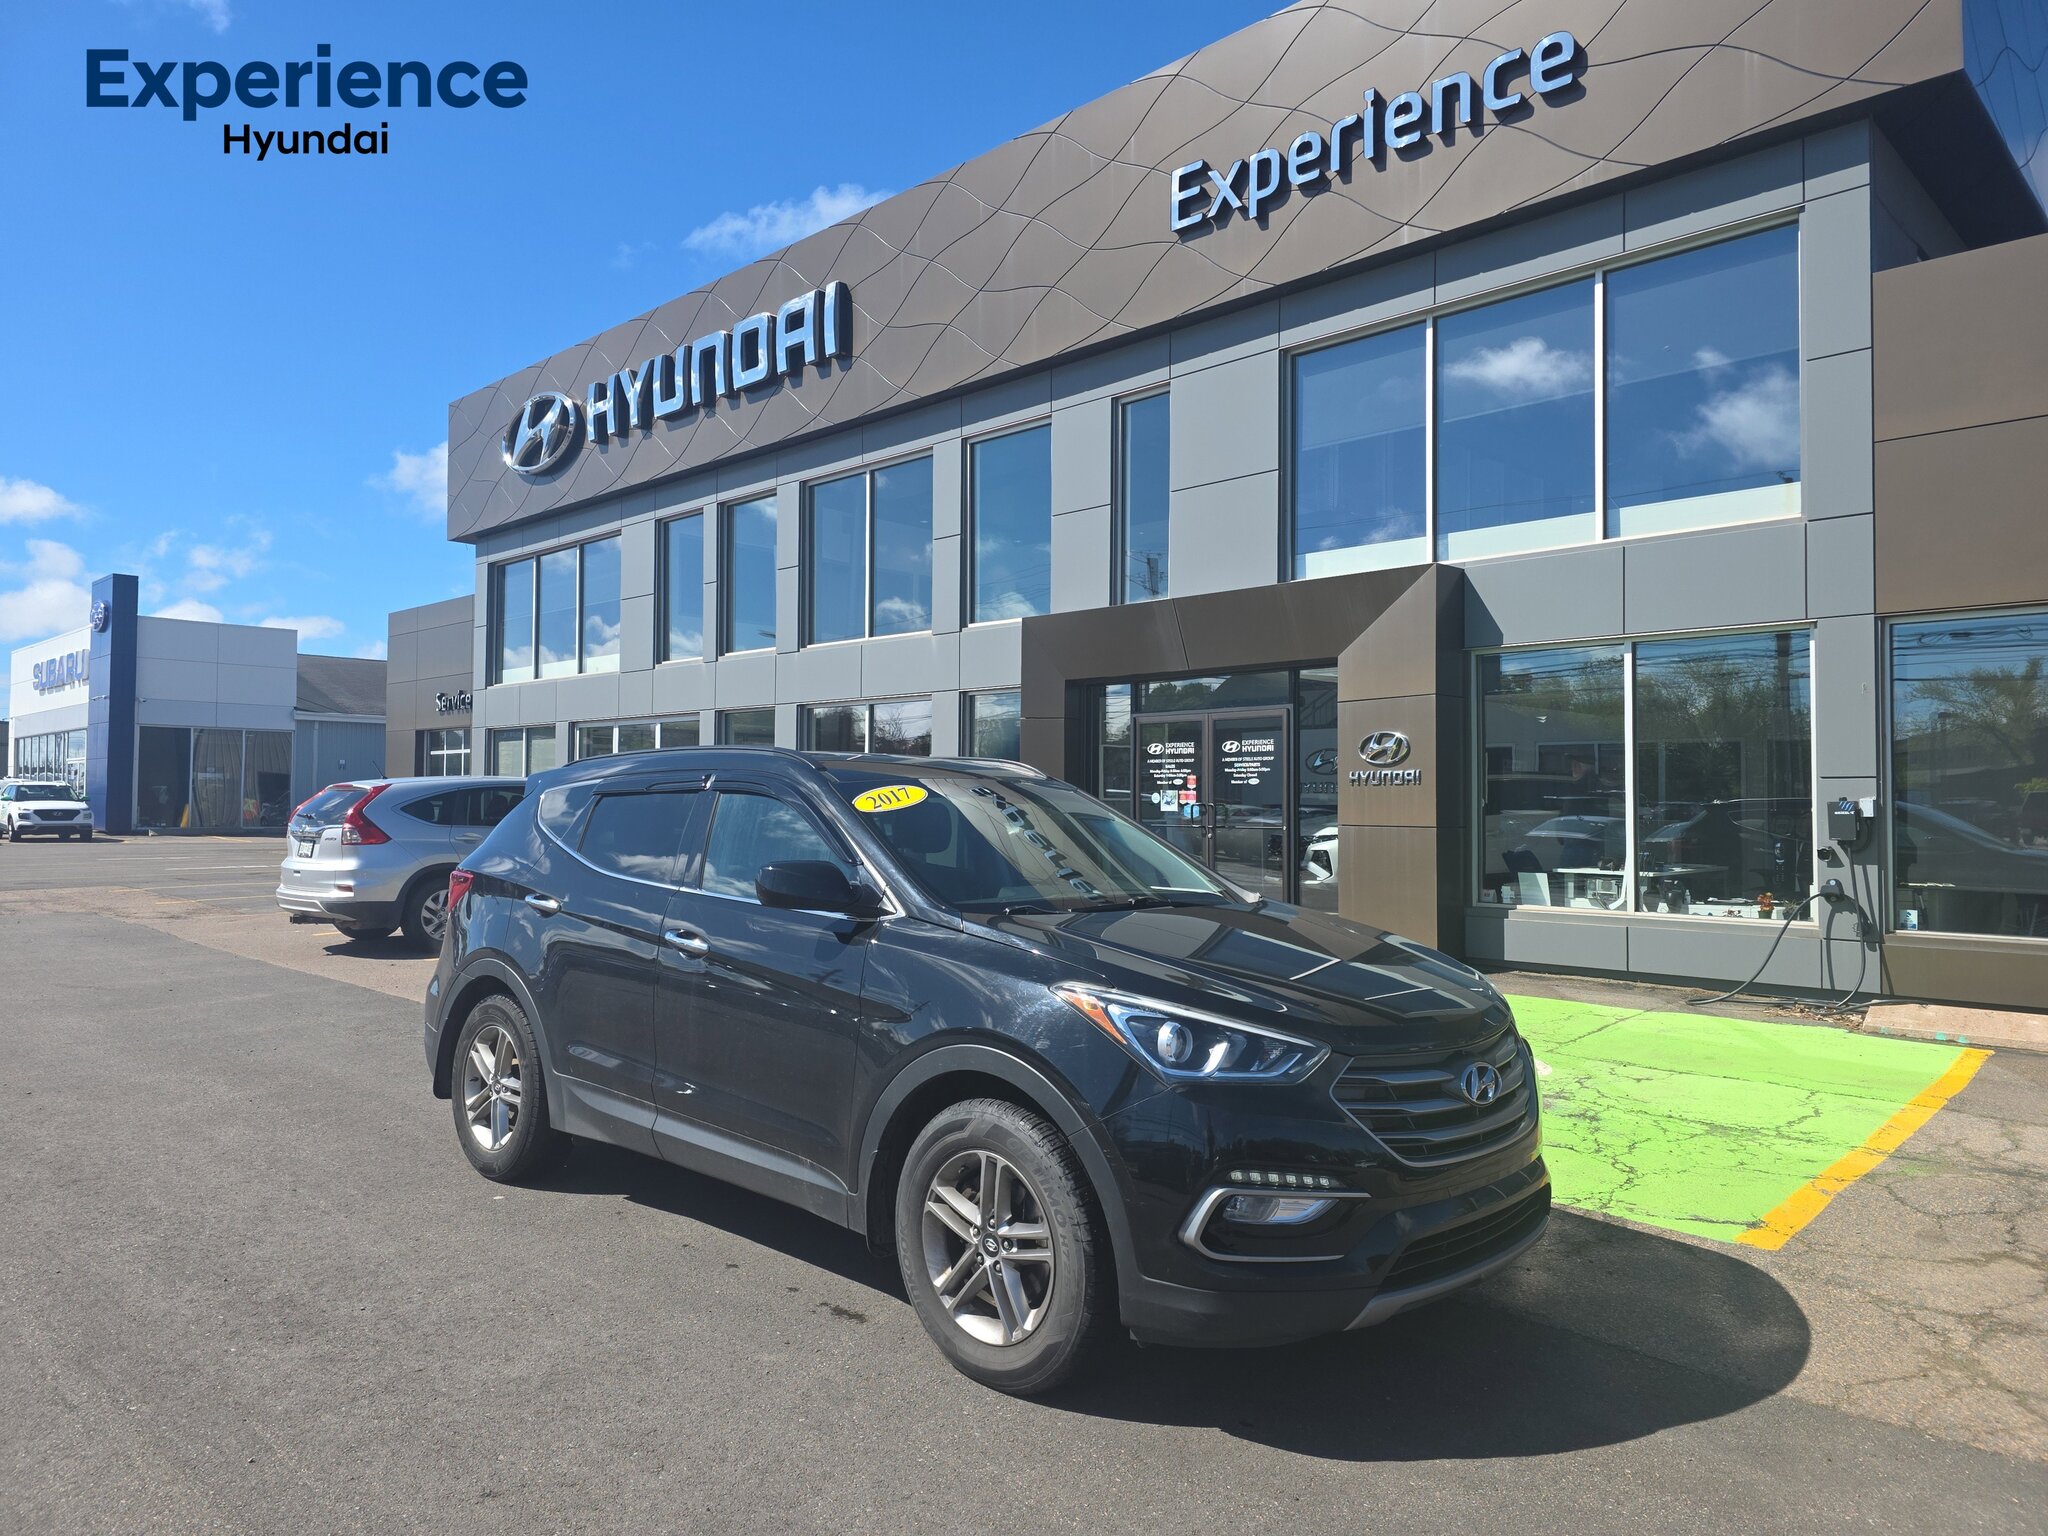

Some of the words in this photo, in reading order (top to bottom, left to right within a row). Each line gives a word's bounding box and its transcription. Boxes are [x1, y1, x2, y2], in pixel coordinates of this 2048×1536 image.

[1170, 30, 1580, 232] Experience
[587, 280, 852, 443] HYUNDAI
[33, 650, 89, 692] SUBARU
[435, 690, 472, 711] Service
[1349, 769, 1421, 786] HYUNDAI
[865, 787, 910, 809] 2017
